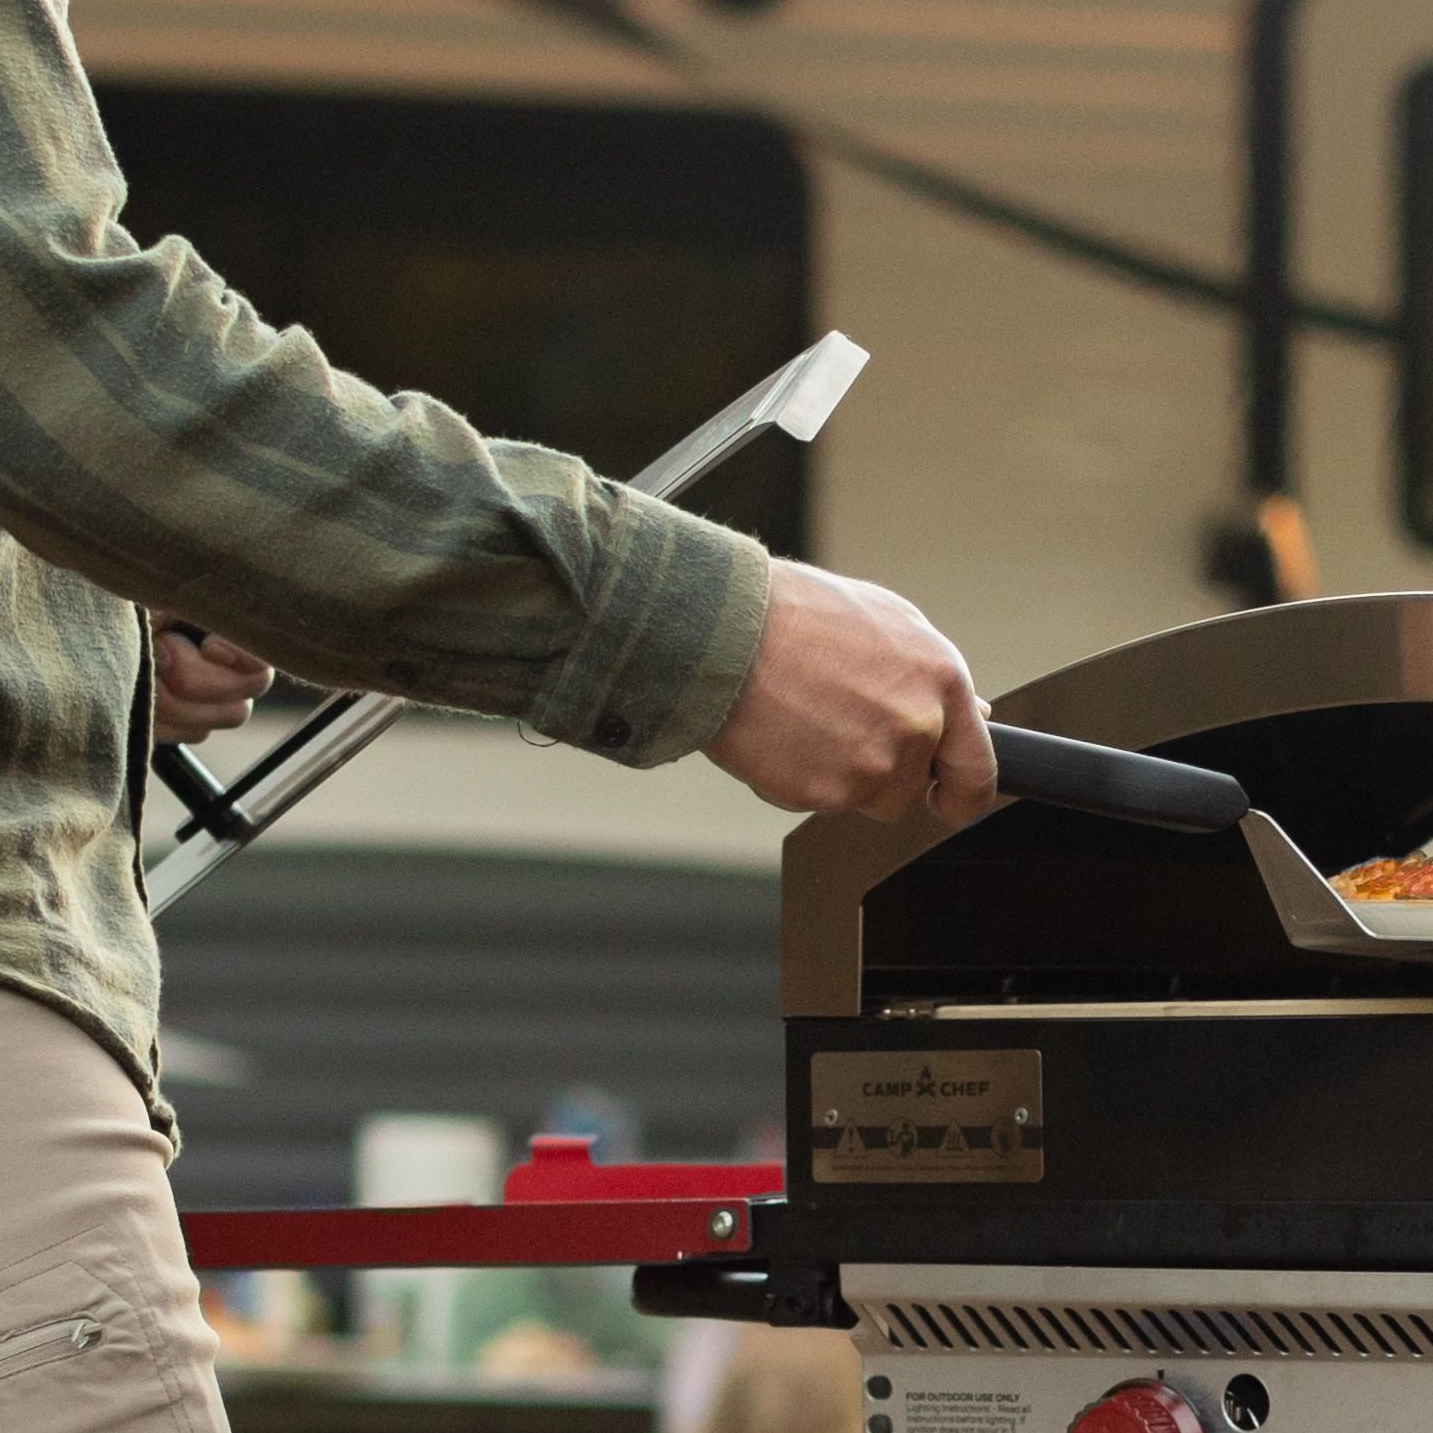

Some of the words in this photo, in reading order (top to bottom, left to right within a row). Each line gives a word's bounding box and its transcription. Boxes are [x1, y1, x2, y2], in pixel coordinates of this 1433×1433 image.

[862, 1081, 912, 1097] CAMP
[940, 1081, 990, 1097] CHEF
[906, 1392, 926, 1402] FOR
[927, 1392, 973, 1402] OUTDOOR
[975, 1393, 993, 1403] USE
[996, 1393, 1020, 1403] ONLY
